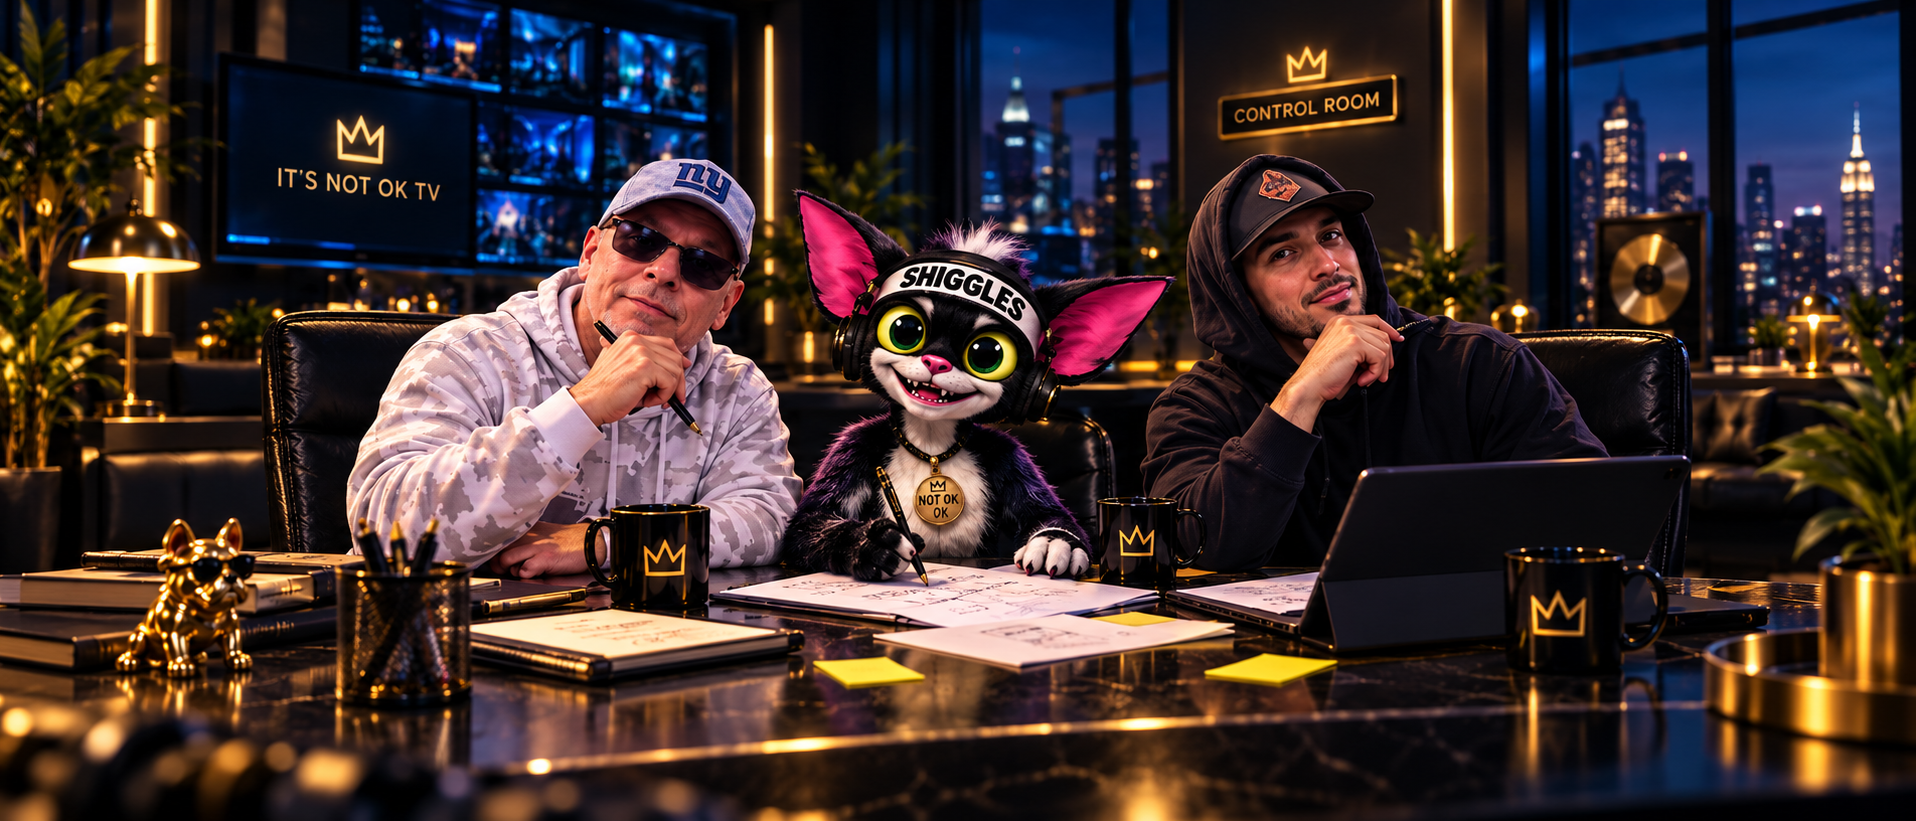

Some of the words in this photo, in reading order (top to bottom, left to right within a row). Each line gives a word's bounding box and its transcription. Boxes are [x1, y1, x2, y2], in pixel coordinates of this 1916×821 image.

[1234, 100, 1318, 124] CONTROL
[1324, 91, 1380, 113] ROOM
[277, 167, 318, 190] IT'S
[326, 172, 371, 195] NOT
[378, 178, 408, 199] OK
[414, 182, 441, 201] TV
[900, 265, 1026, 321] SHIGGLES
[918, 494, 941, 506] NOT
[943, 493, 959, 505] OK
[933, 507, 948, 518] OK
